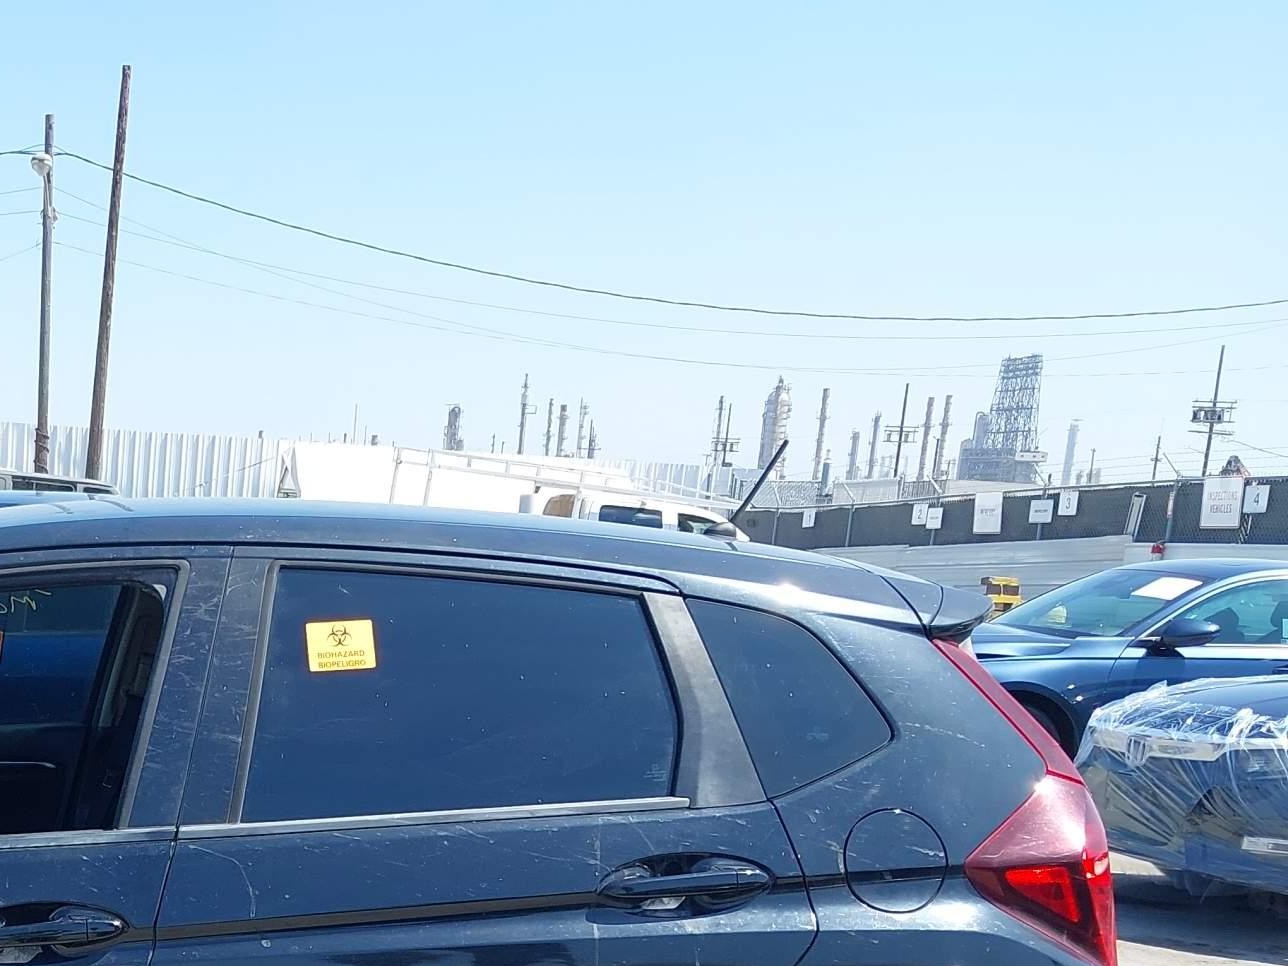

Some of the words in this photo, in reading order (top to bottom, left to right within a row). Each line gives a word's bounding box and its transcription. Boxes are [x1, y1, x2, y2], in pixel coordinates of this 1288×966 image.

[1065, 497, 1072, 510] 3
[1253, 492, 1261, 506] 4
[917, 508, 923, 520] 2
[317, 649, 365, 659] BIOHAZARD
[317, 659, 367, 669] BIOPELIGRO
